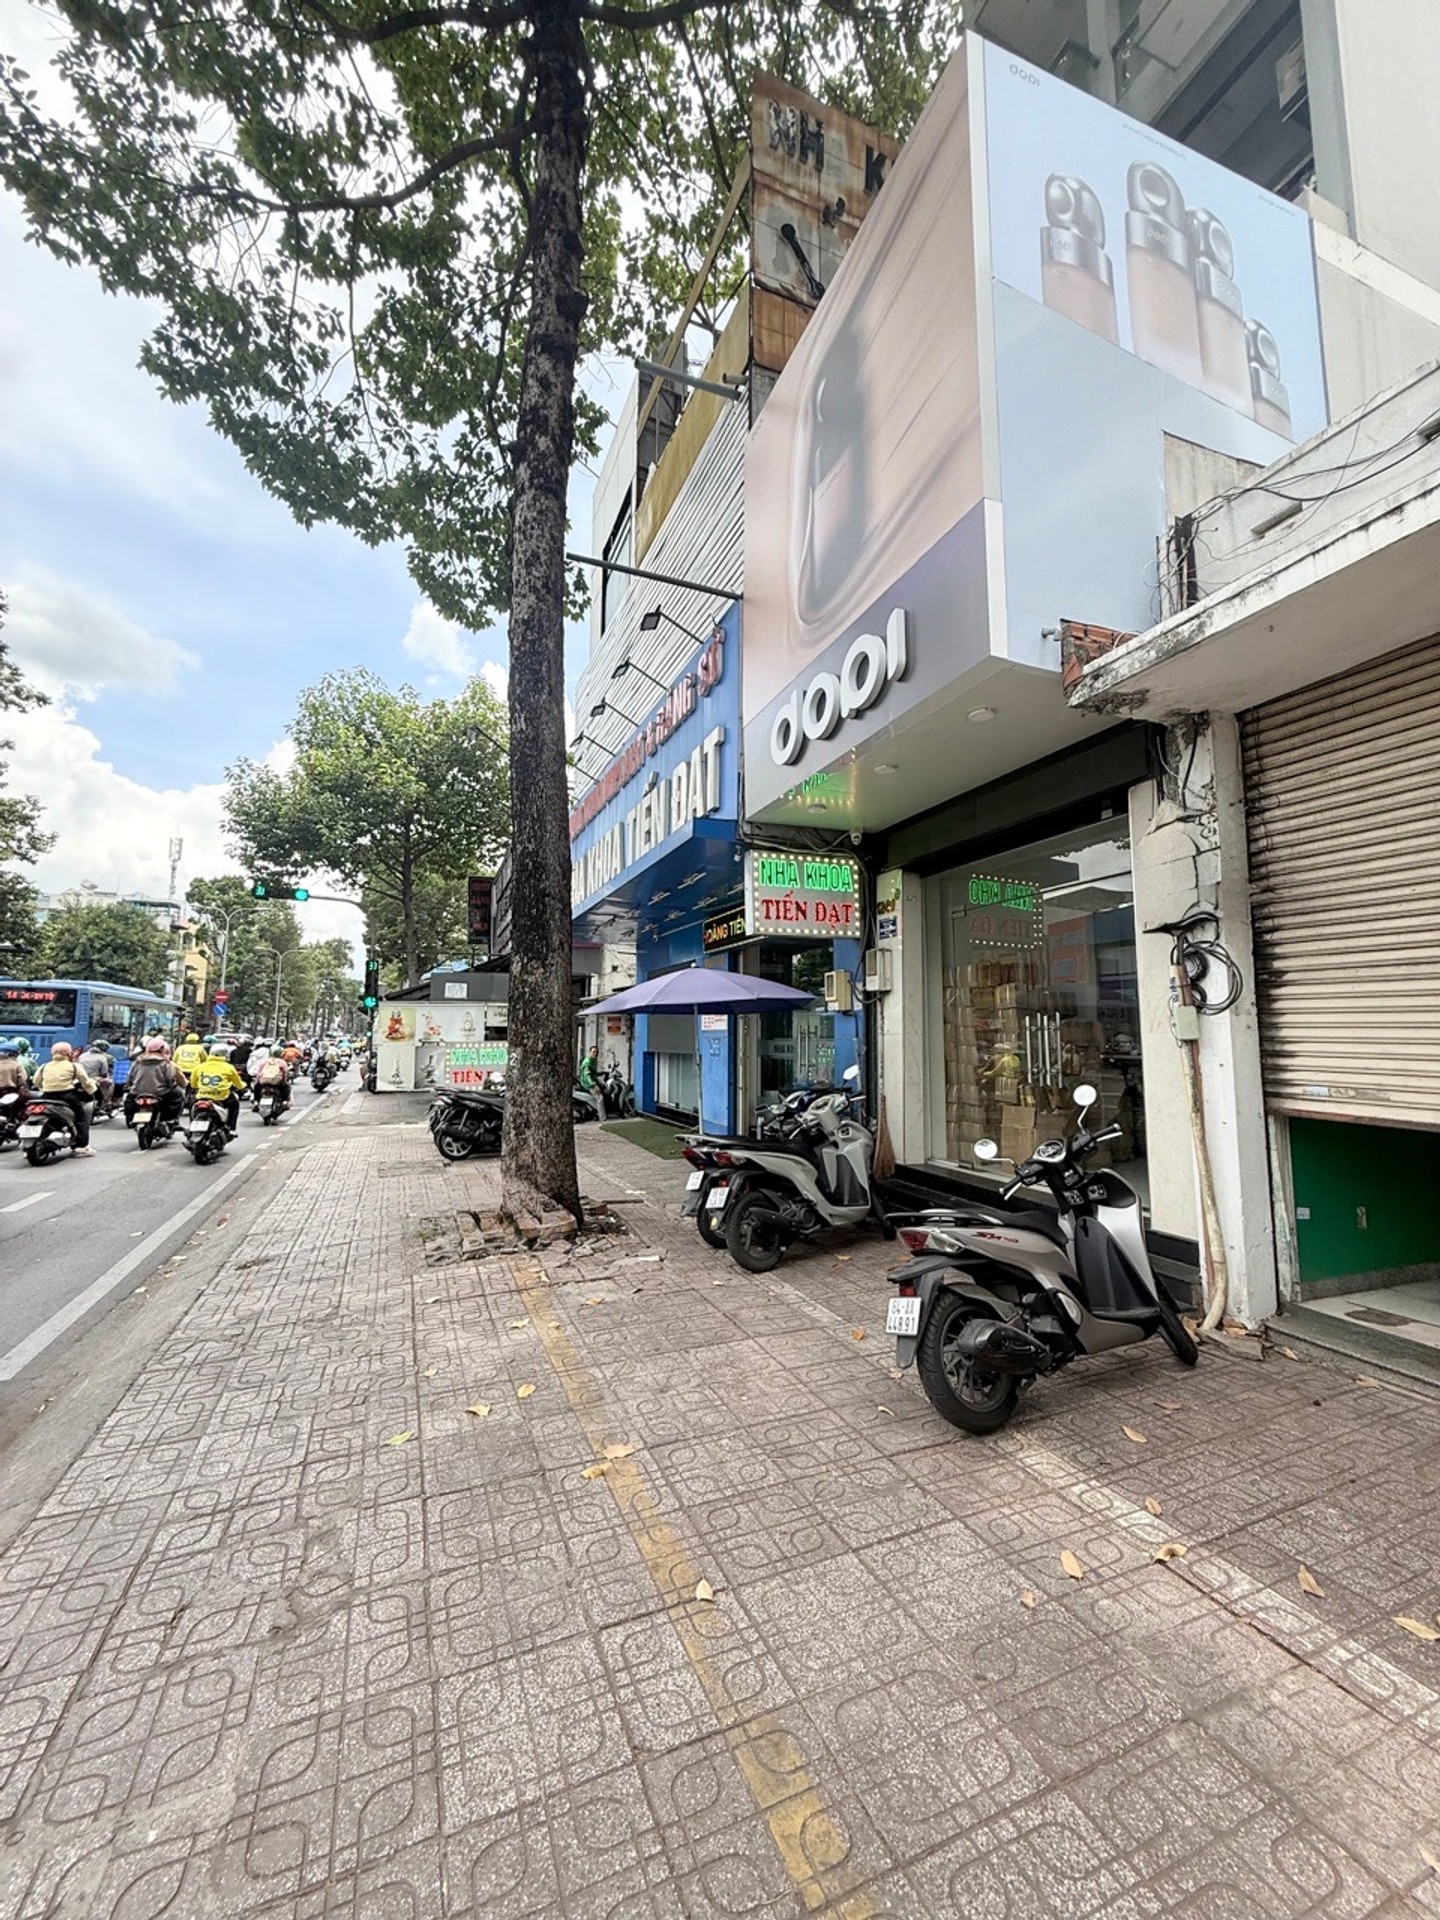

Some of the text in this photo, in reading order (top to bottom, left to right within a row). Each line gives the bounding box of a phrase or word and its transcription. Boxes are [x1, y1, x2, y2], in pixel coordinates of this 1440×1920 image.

[587, 821, 624, 899] KHOA
[627, 770, 671, 868] TIẾN
[759, 858, 853, 893] NHA KHOA
[761, 889, 808, 922] TIẾN
[814, 902, 853, 929] ĐẠT
[450, 1047, 508, 1065] NHA KHO
[200, 1071, 224, 1086] be
